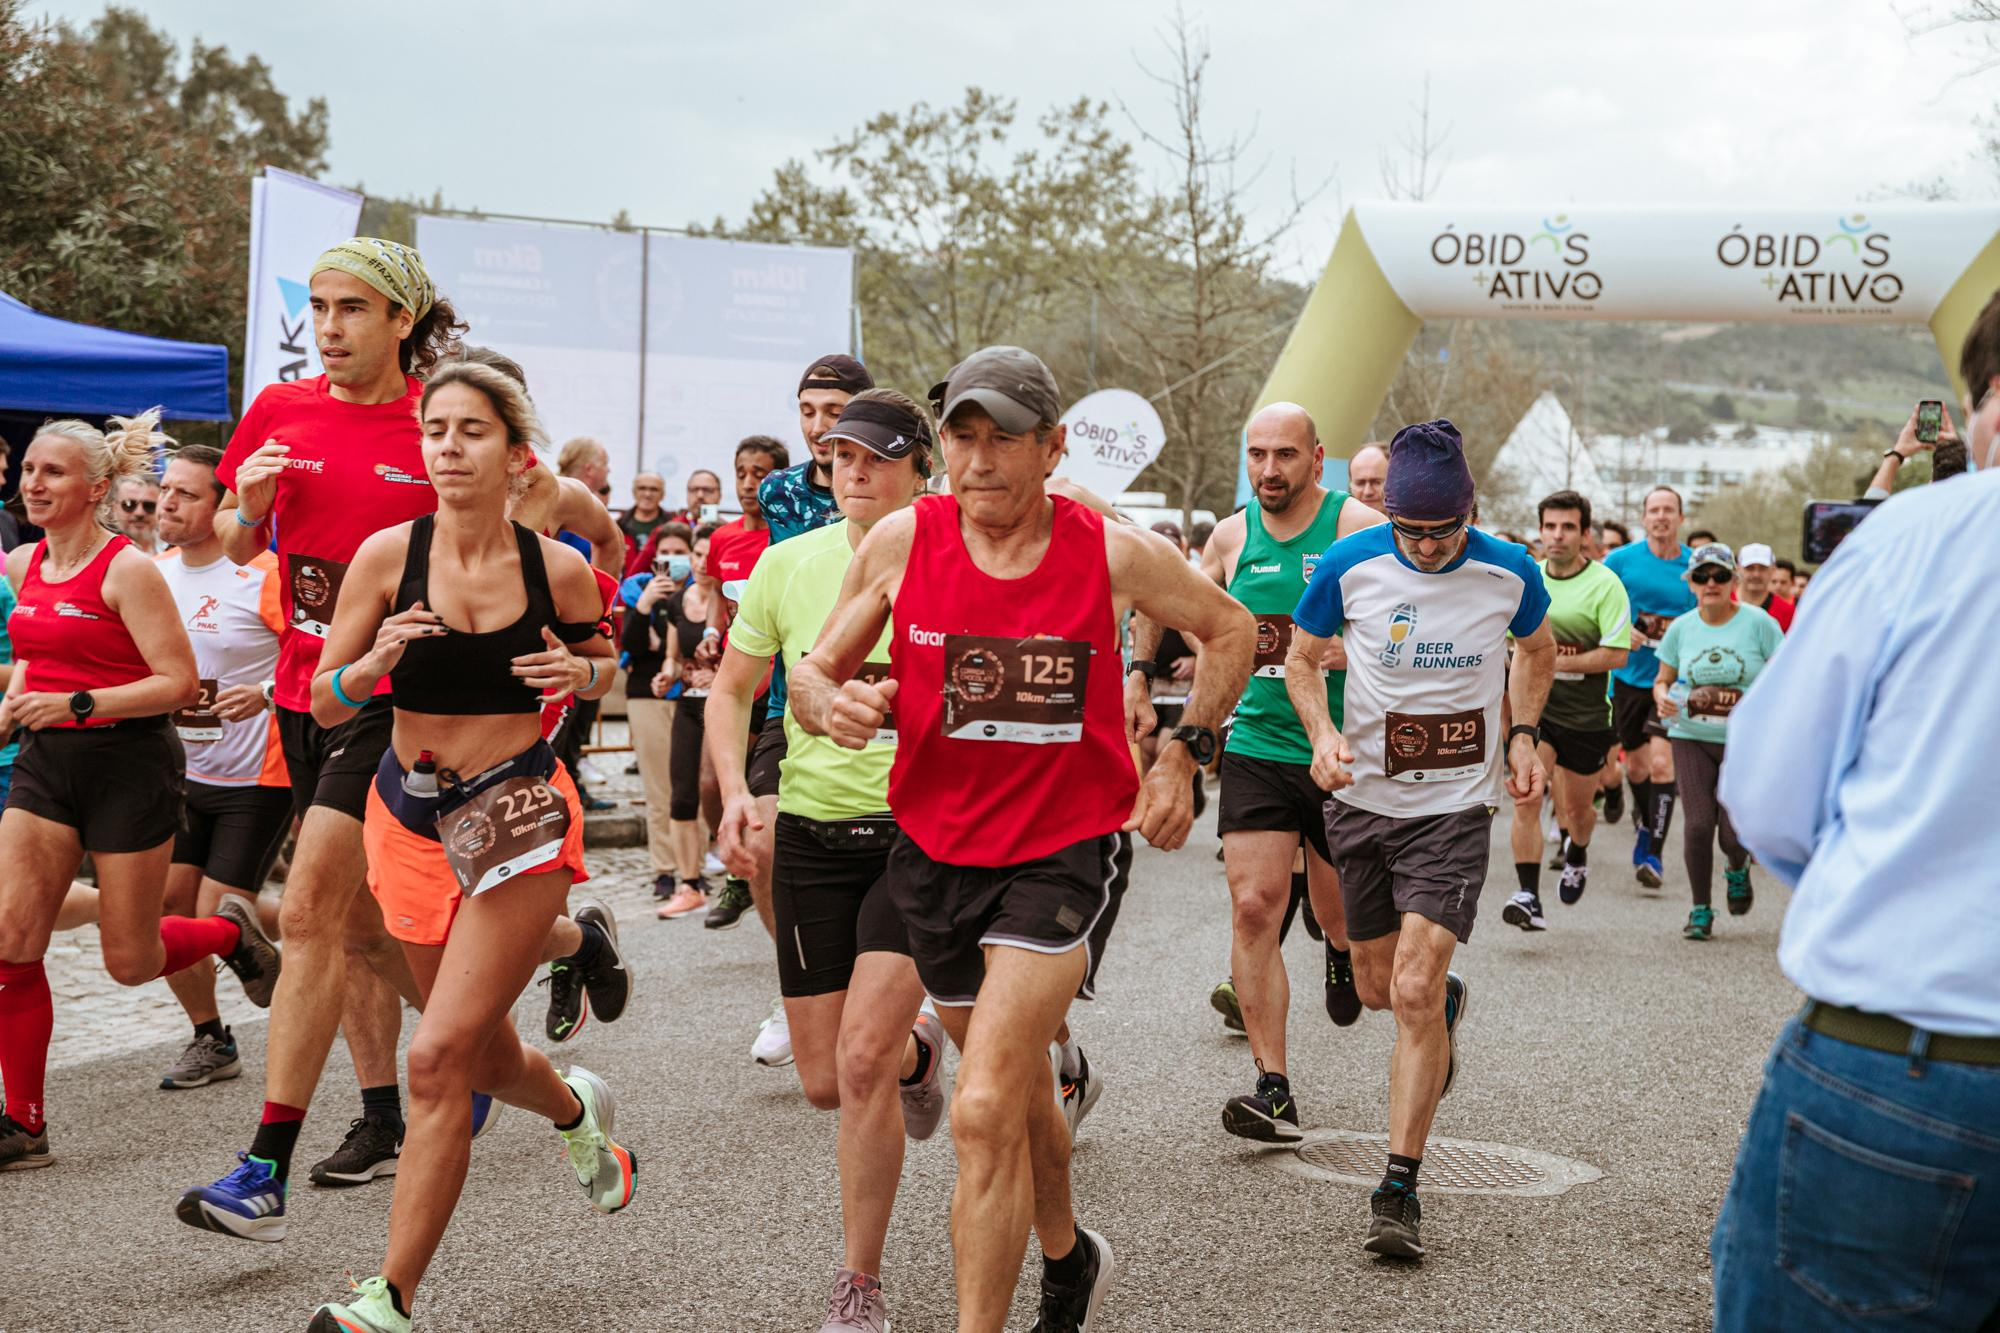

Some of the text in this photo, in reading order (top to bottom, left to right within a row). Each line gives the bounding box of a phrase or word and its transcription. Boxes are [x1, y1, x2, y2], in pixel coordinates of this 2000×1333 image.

[1251, 563, 1281, 574] hummel
[197, 622, 218, 630] PNAC
[1416, 642, 1454, 655] BEER
[1412, 654, 1483, 669] RUNNERS
[1021, 654, 1075, 685] 125
[1016, 691, 1045, 704] 10km
[1718, 691, 1737, 704] 171
[1440, 720, 1477, 742] 129
[1437, 747, 1457, 755] 10km
[496, 784, 553, 822] 229
[510, 821, 537, 838] 10km
[851, 827, 875, 835] FILA
